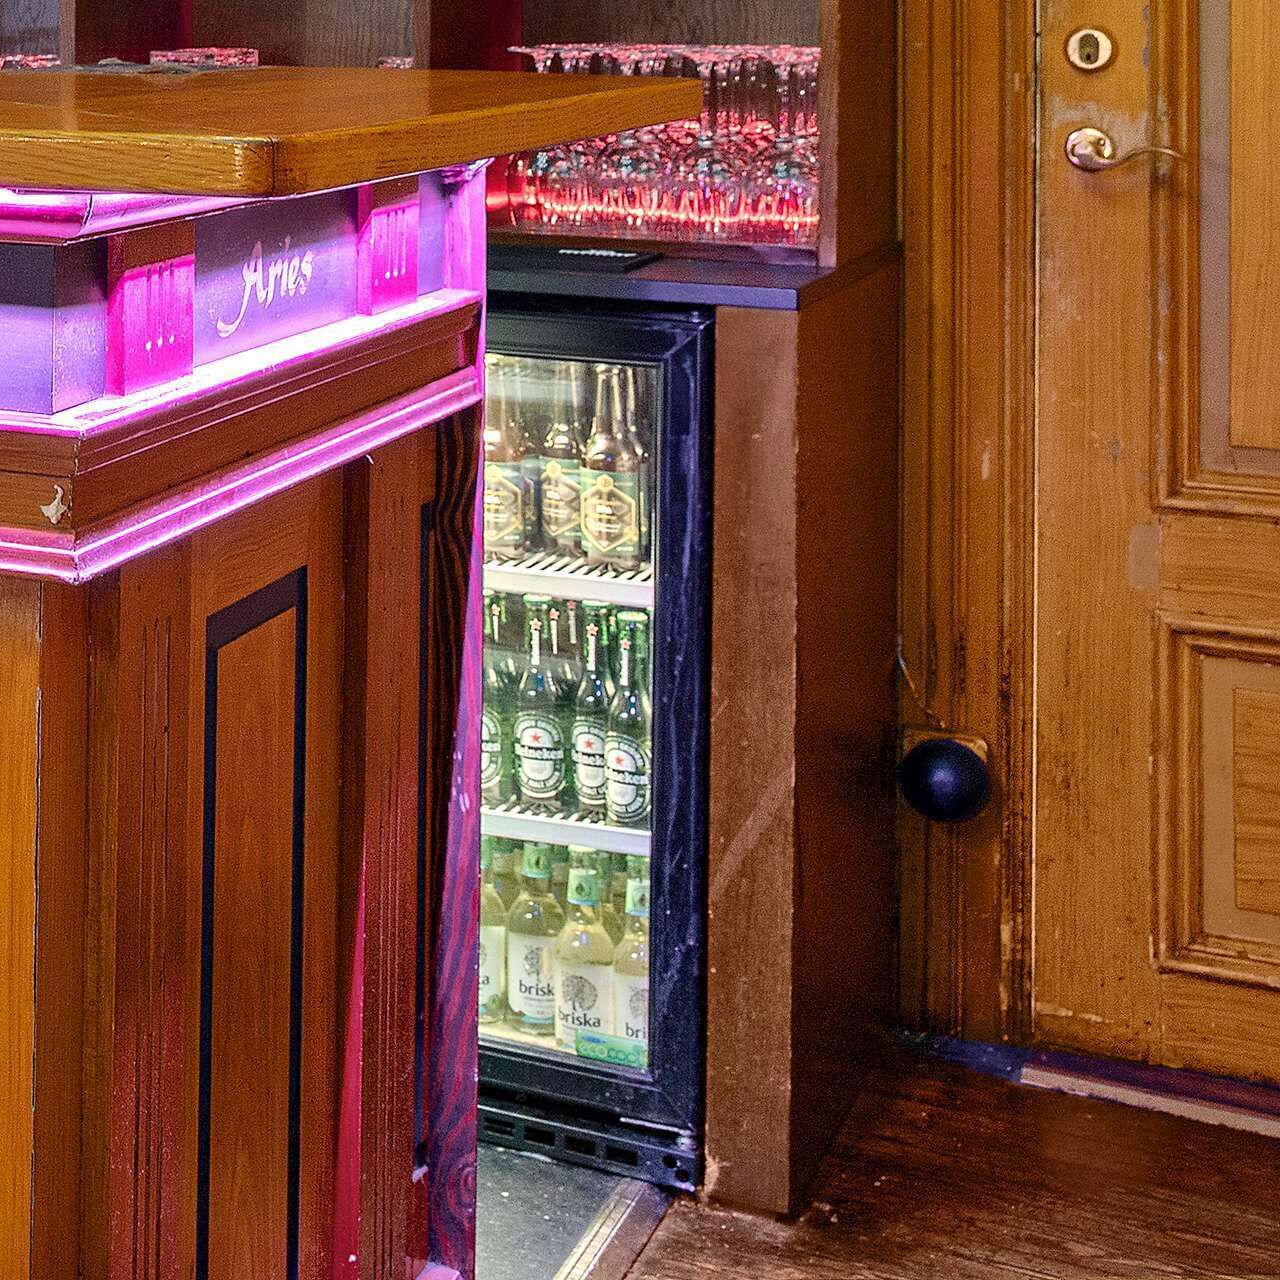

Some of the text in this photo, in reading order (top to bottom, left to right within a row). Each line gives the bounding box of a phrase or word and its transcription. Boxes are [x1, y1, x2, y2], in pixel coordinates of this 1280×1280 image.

[215, 234, 314, 339] Aries
[519, 979, 555, 997] brisk
[558, 1007, 601, 1028] briska
